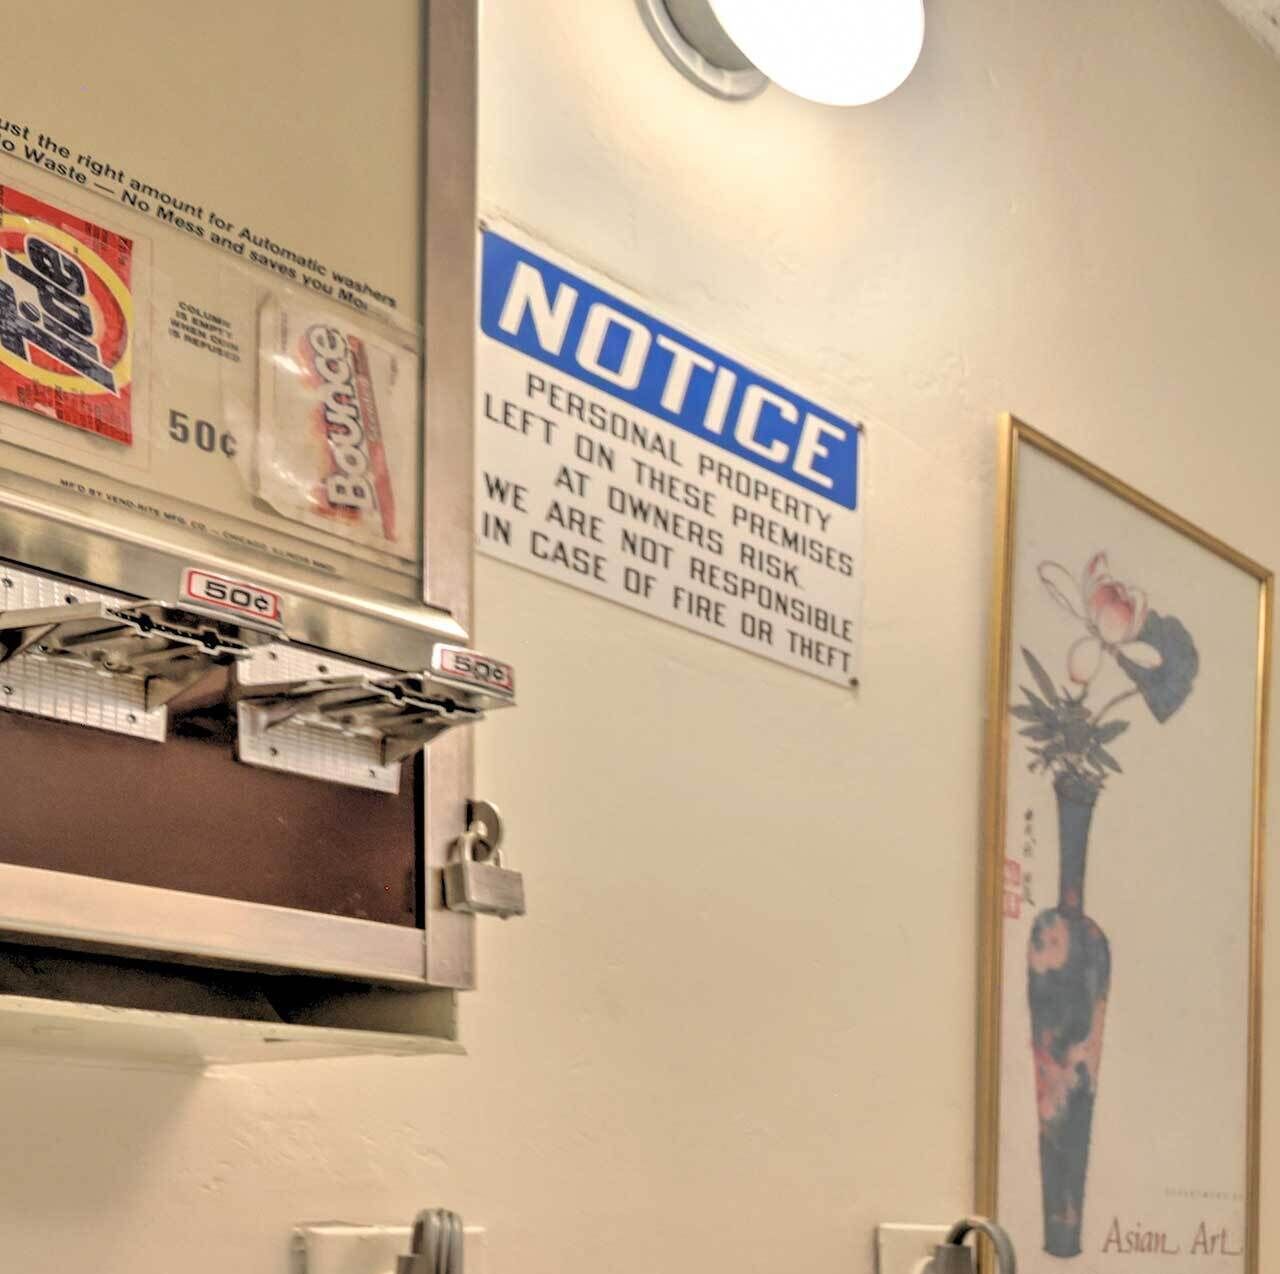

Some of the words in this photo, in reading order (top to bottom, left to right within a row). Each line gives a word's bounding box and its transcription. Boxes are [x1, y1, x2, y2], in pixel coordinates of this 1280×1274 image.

[0, 118, 30, 140] ust
[38, 133, 70, 159] the
[77, 154, 125, 184] right
[130, 177, 205, 220] amount
[208, 212, 235, 233] for
[239, 227, 328, 276] Automatic
[332, 271, 397, 309] washers
[24, 145, 87, 185] Waste
[121, 190, 150, 212] No
[156, 207, 205, 238] Mess
[210, 232, 246, 255] and
[249, 251, 297, 279] saves
[302, 273, 334, 296] you
[168, 408, 238, 459] 50¢
[498, 260, 847, 489] NOTICE
[526, 372, 683, 468] PERSONAL
[698, 452, 833, 533] PROPERTY
[482, 472, 528, 514] WE
[545, 500, 604, 544] ARE
[621, 528, 675, 570] NOT
[690, 558, 854, 643] RESPONSIBLE
[483, 393, 559, 447] LEFT
[574, 434, 615, 473] ON
[635, 459, 717, 518] THESE
[732, 504, 854, 577] PREMISES
[554, 465, 592, 498] AT
[607, 487, 724, 555] OWNERS
[203, 579, 270, 612] 50¢
[453, 654, 504, 682] 50¢
[482, 511, 512, 547] IN
[529, 531, 607, 584] CASE
[623, 567, 657, 599] OF
[673, 586, 727, 627] FIRE
[741, 614, 774, 646] OR
[787, 627, 853, 674] THEFT
[1102, 1215, 1181, 1255] Asian
[1190, 1220, 1244, 1257] Art
